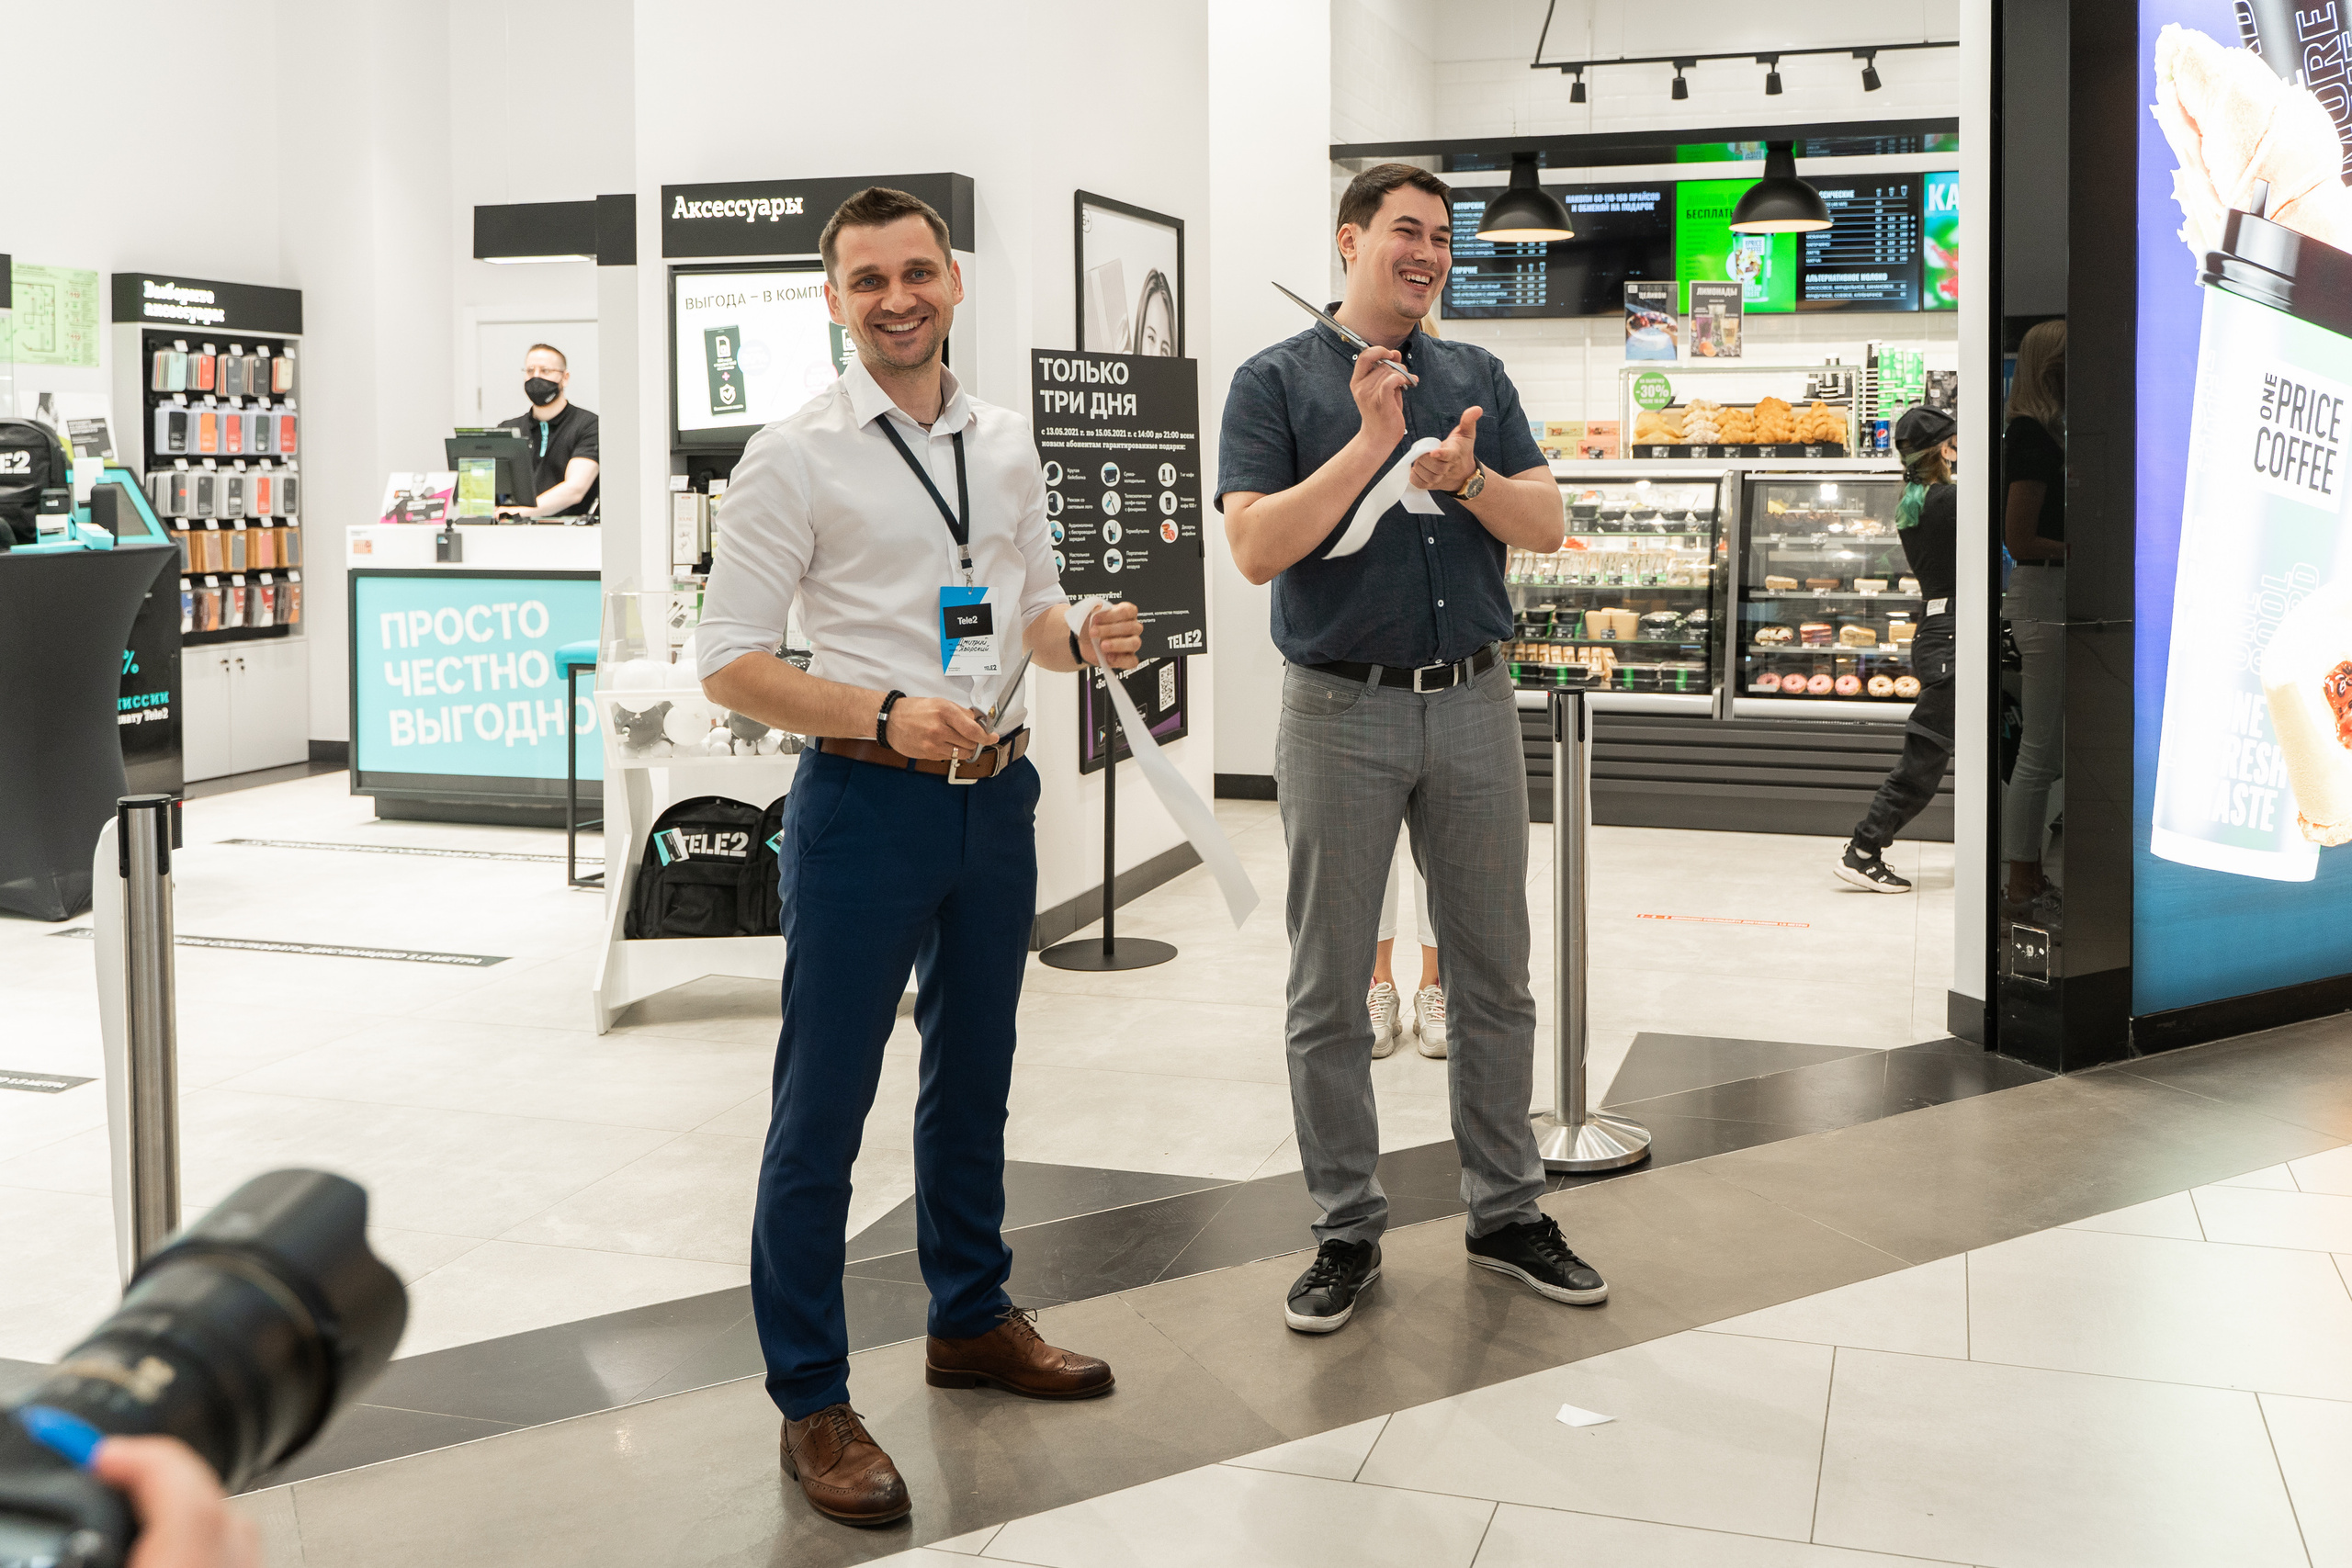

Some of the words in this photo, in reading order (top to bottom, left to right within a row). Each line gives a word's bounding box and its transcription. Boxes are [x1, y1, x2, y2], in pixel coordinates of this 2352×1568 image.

[672, 196, 804, 223] Аксессуары
[1622, 202, 1655, 212] ПОДАРОК
[685, 293, 746, 310] ВЫГОДА
[763, 290, 773, 303] В
[1697, 287, 1737, 297] ЛИМОНАДЫ
[1039, 357, 1129, 386] ТОЛЬКО
[1039, 389, 1085, 414] ТРИ
[1090, 392, 1137, 420] ДНЯ
[1635, 384, 1669, 398] -30%
[2260, 372, 2278, 420] ONE
[2275, 378, 2344, 444] PRICE
[1046, 427, 1079, 436] 13.05.2021
[1095, 428, 1126, 437] 15.05.2021
[1137, 430, 1154, 438] 14:00
[1163, 431, 1179, 439] 21:00
[1066, 440, 1102, 448] абонентам
[2254, 426, 2337, 495] COFFEE
[379, 600, 549, 650] ПРОСТО
[957, 615, 978, 625] Tele2
[1168, 629, 1203, 649] TELE2
[384, 649, 549, 697] ЧЕСТНО
[142, 706, 169, 722] Tele2
[389, 695, 598, 748] ВЫГОДНО
[2231, 690, 2267, 739] NE
[2218, 735, 2290, 789] RESH
[2211, 779, 2278, 832] ASTE
